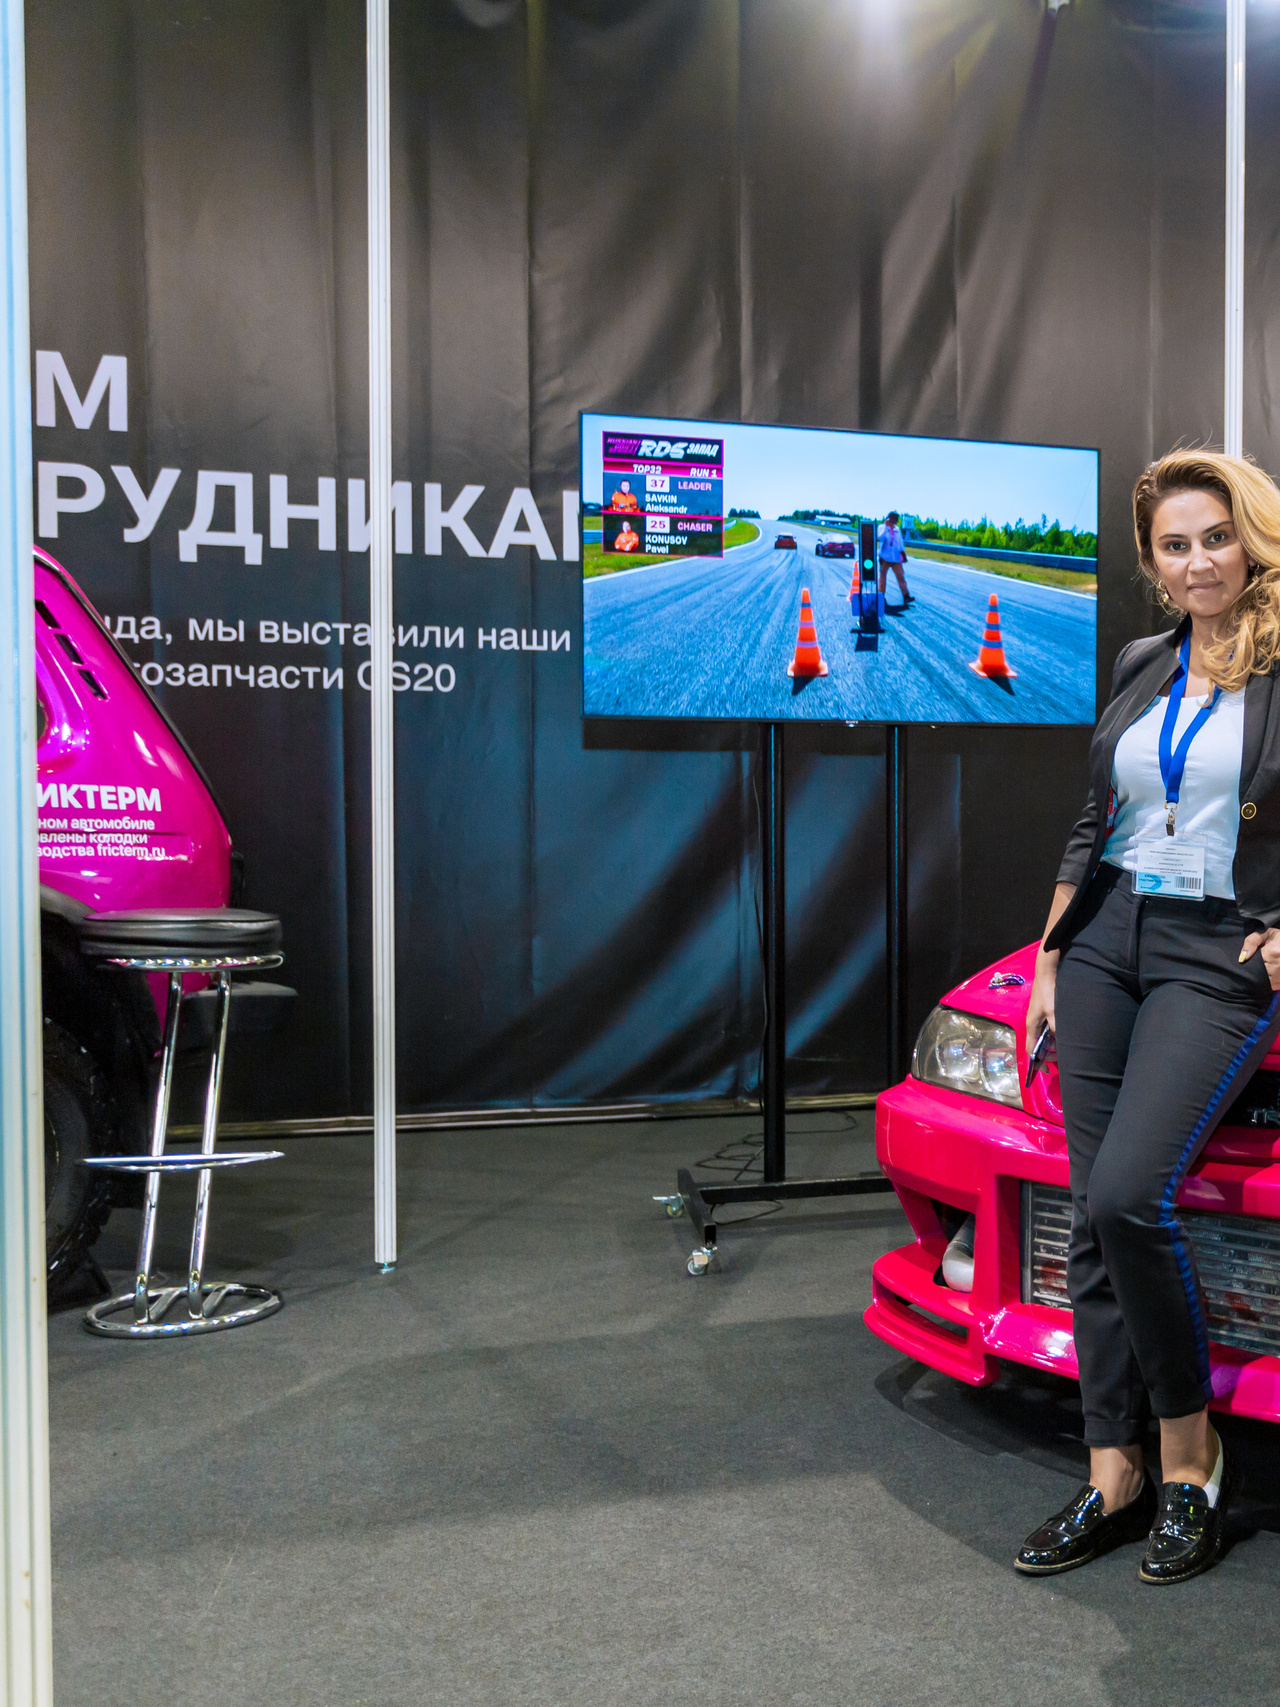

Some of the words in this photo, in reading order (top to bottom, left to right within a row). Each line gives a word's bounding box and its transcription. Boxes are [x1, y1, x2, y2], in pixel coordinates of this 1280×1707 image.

[36, 350, 128, 432] М
[638, 439, 688, 459] RDS
[633, 464, 662, 474] TOP32
[690, 467, 709, 478] RUN
[650, 479, 666, 488] 37
[678, 481, 712, 491] LEADER
[645, 494, 678, 503] SAVKIN
[645, 503, 688, 514] Aleksandr
[650, 520, 666, 529] 25
[677, 521, 713, 532] CHASER
[645, 534, 688, 545] KONUSOV
[645, 544, 669, 554] Pavel
[188, 617, 245, 642] мы
[259, 619, 465, 649] выстаили
[477, 626, 572, 652] наши
[133, 660, 344, 690] озапчасти
[71, 816, 155, 830] автомобиле
[89, 832, 148, 845] колодки
[97, 844, 166, 858] fricterm.ru
